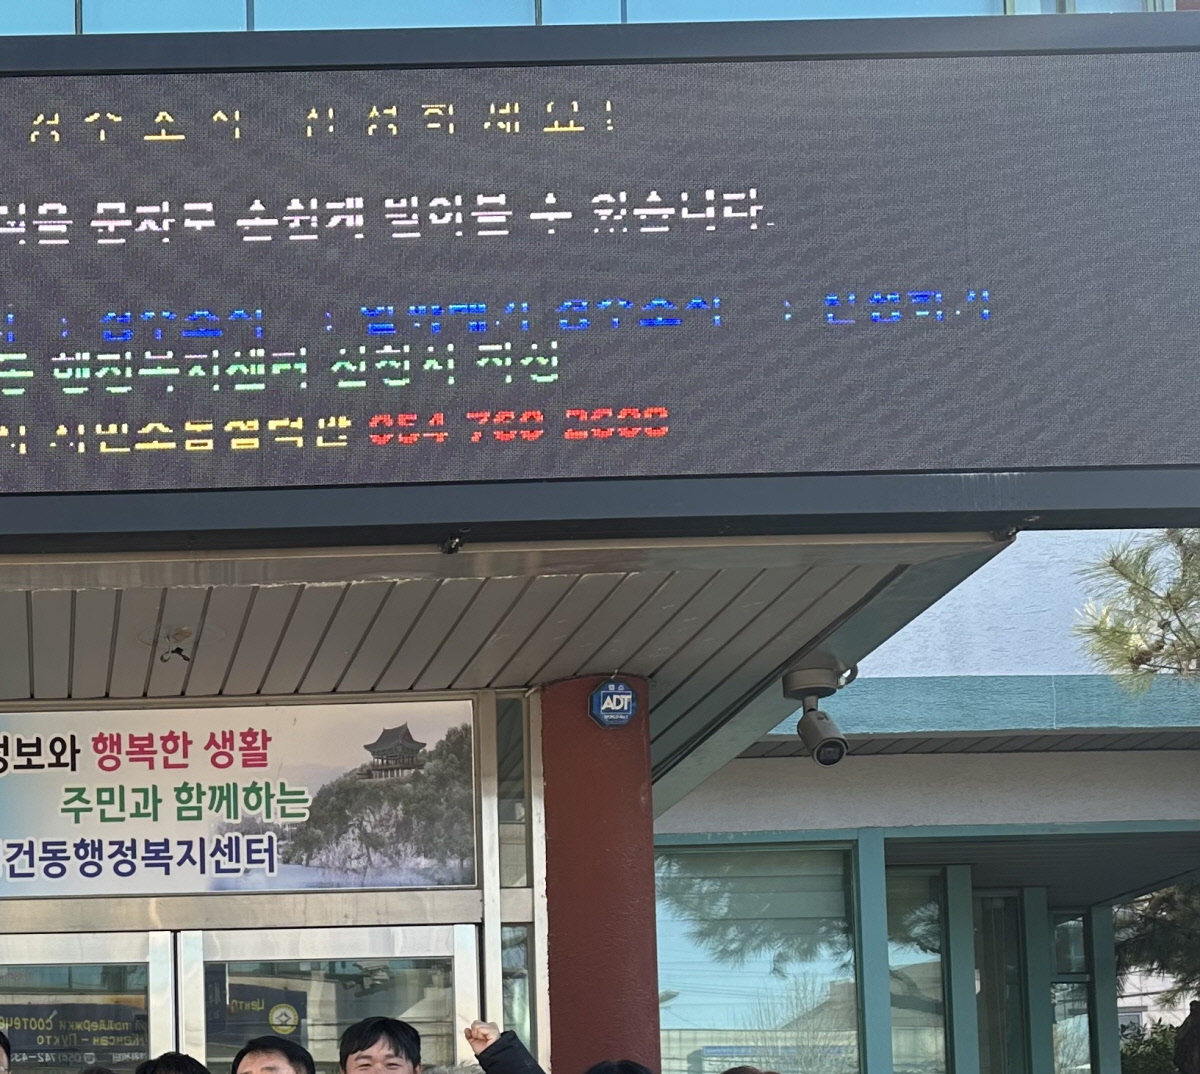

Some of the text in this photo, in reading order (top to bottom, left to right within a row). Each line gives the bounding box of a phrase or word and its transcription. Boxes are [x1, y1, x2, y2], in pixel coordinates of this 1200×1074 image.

[602, 695, 632, 710] ADT
[92, 730, 193, 772] 행복한
[204, 727, 272, 768] 생활
[61, 780, 311, 824] 주민과 함께하는
